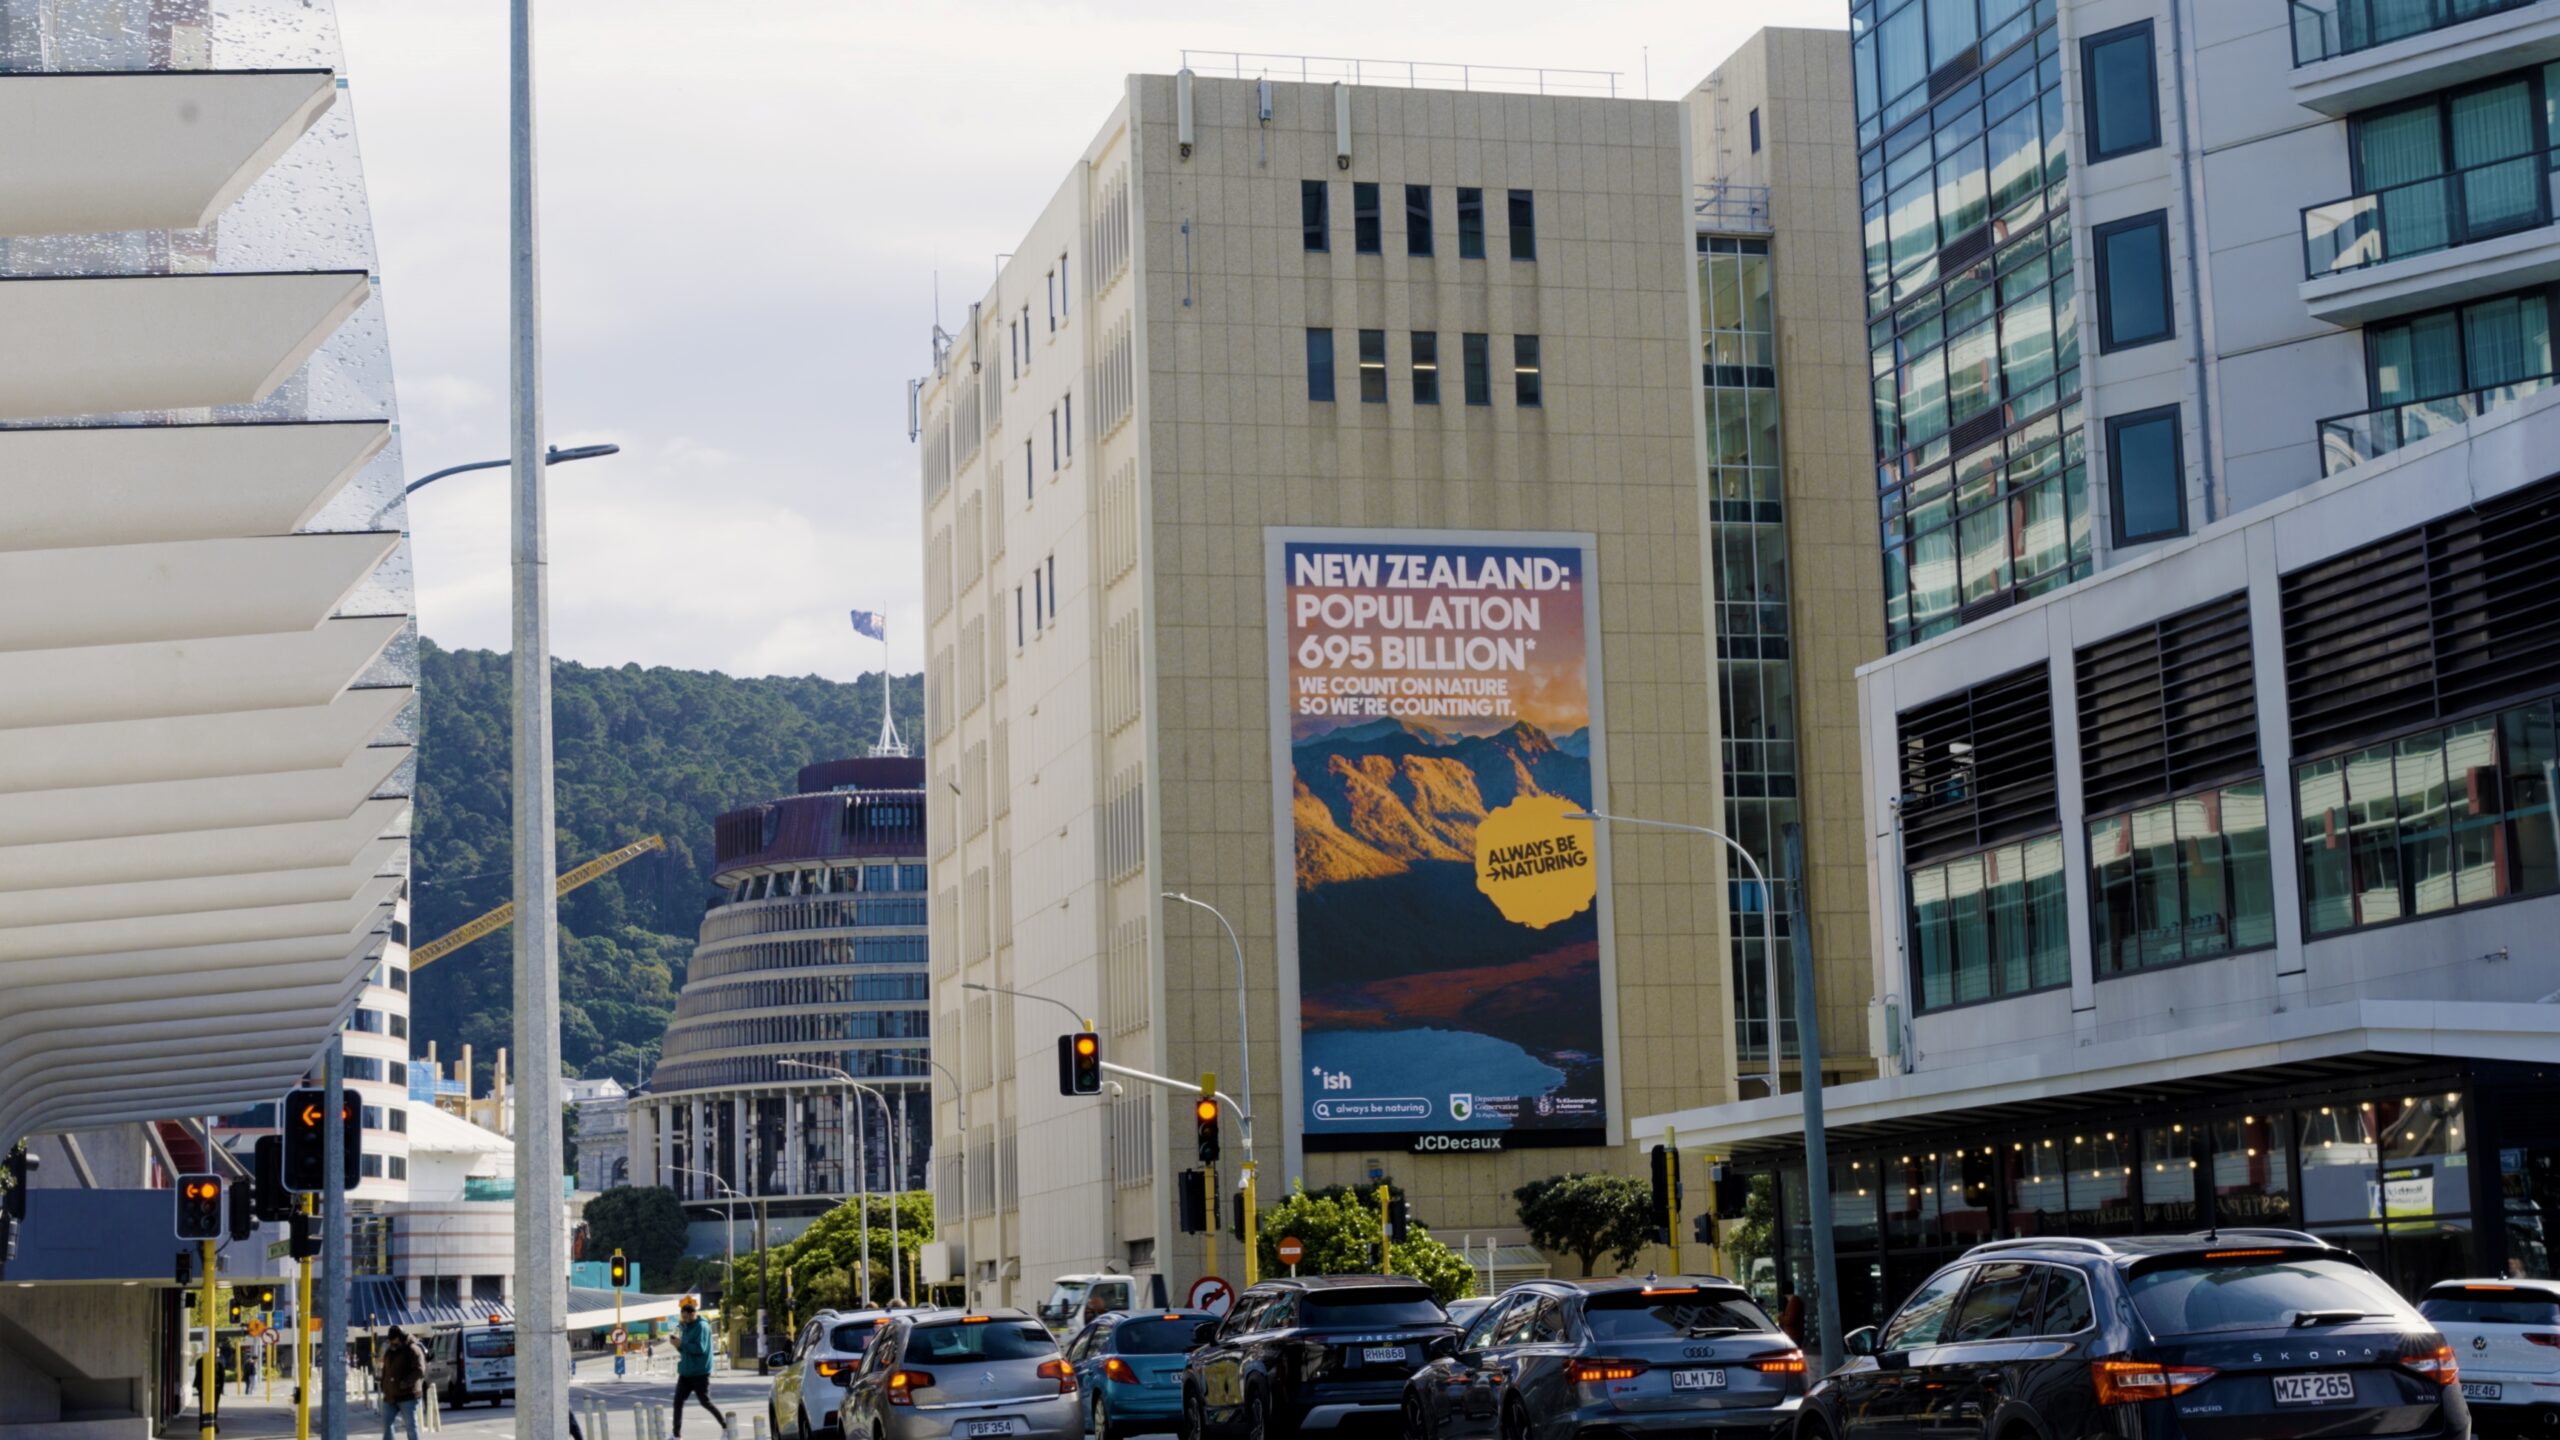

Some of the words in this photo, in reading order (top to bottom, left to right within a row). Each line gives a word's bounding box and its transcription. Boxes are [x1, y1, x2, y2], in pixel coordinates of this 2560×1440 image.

[1294, 553, 1380, 588] NEW
[1385, 554, 1571, 591] ZEALAND:
[1295, 593, 1541, 631] POPULATION
[1297, 634, 1375, 669] 695
[1298, 676, 1328, 695] WE
[1330, 676, 1398, 695] COUNT
[1401, 677, 1432, 695] ON
[1434, 677, 1508, 696] NATURE
[1299, 696, 1328, 715] SO
[1330, 696, 1388, 715] WE'RE
[1390, 697, 1493, 716] COUNTING
[1495, 698, 1517, 716] IT.
[1488, 839, 1554, 866] ALWAYS
[1556, 834, 1577, 853] BE
[1499, 850, 1588, 881] NATURING
[1335, 1103, 1369, 1115] always
[1371, 1103, 1383, 1113] be
[1385, 1103, 1425, 1114] naturing
[1474, 1103, 1520, 1111] Conservation
[1414, 1135, 1502, 1151] JCDecaux
[1365, 1348, 1405, 1361] RHH868
[1674, 1370, 1725, 1387] QLM178
[2274, 1375, 2351, 1401] MZF265
[970, 1421, 1012, 1434] PBF354
